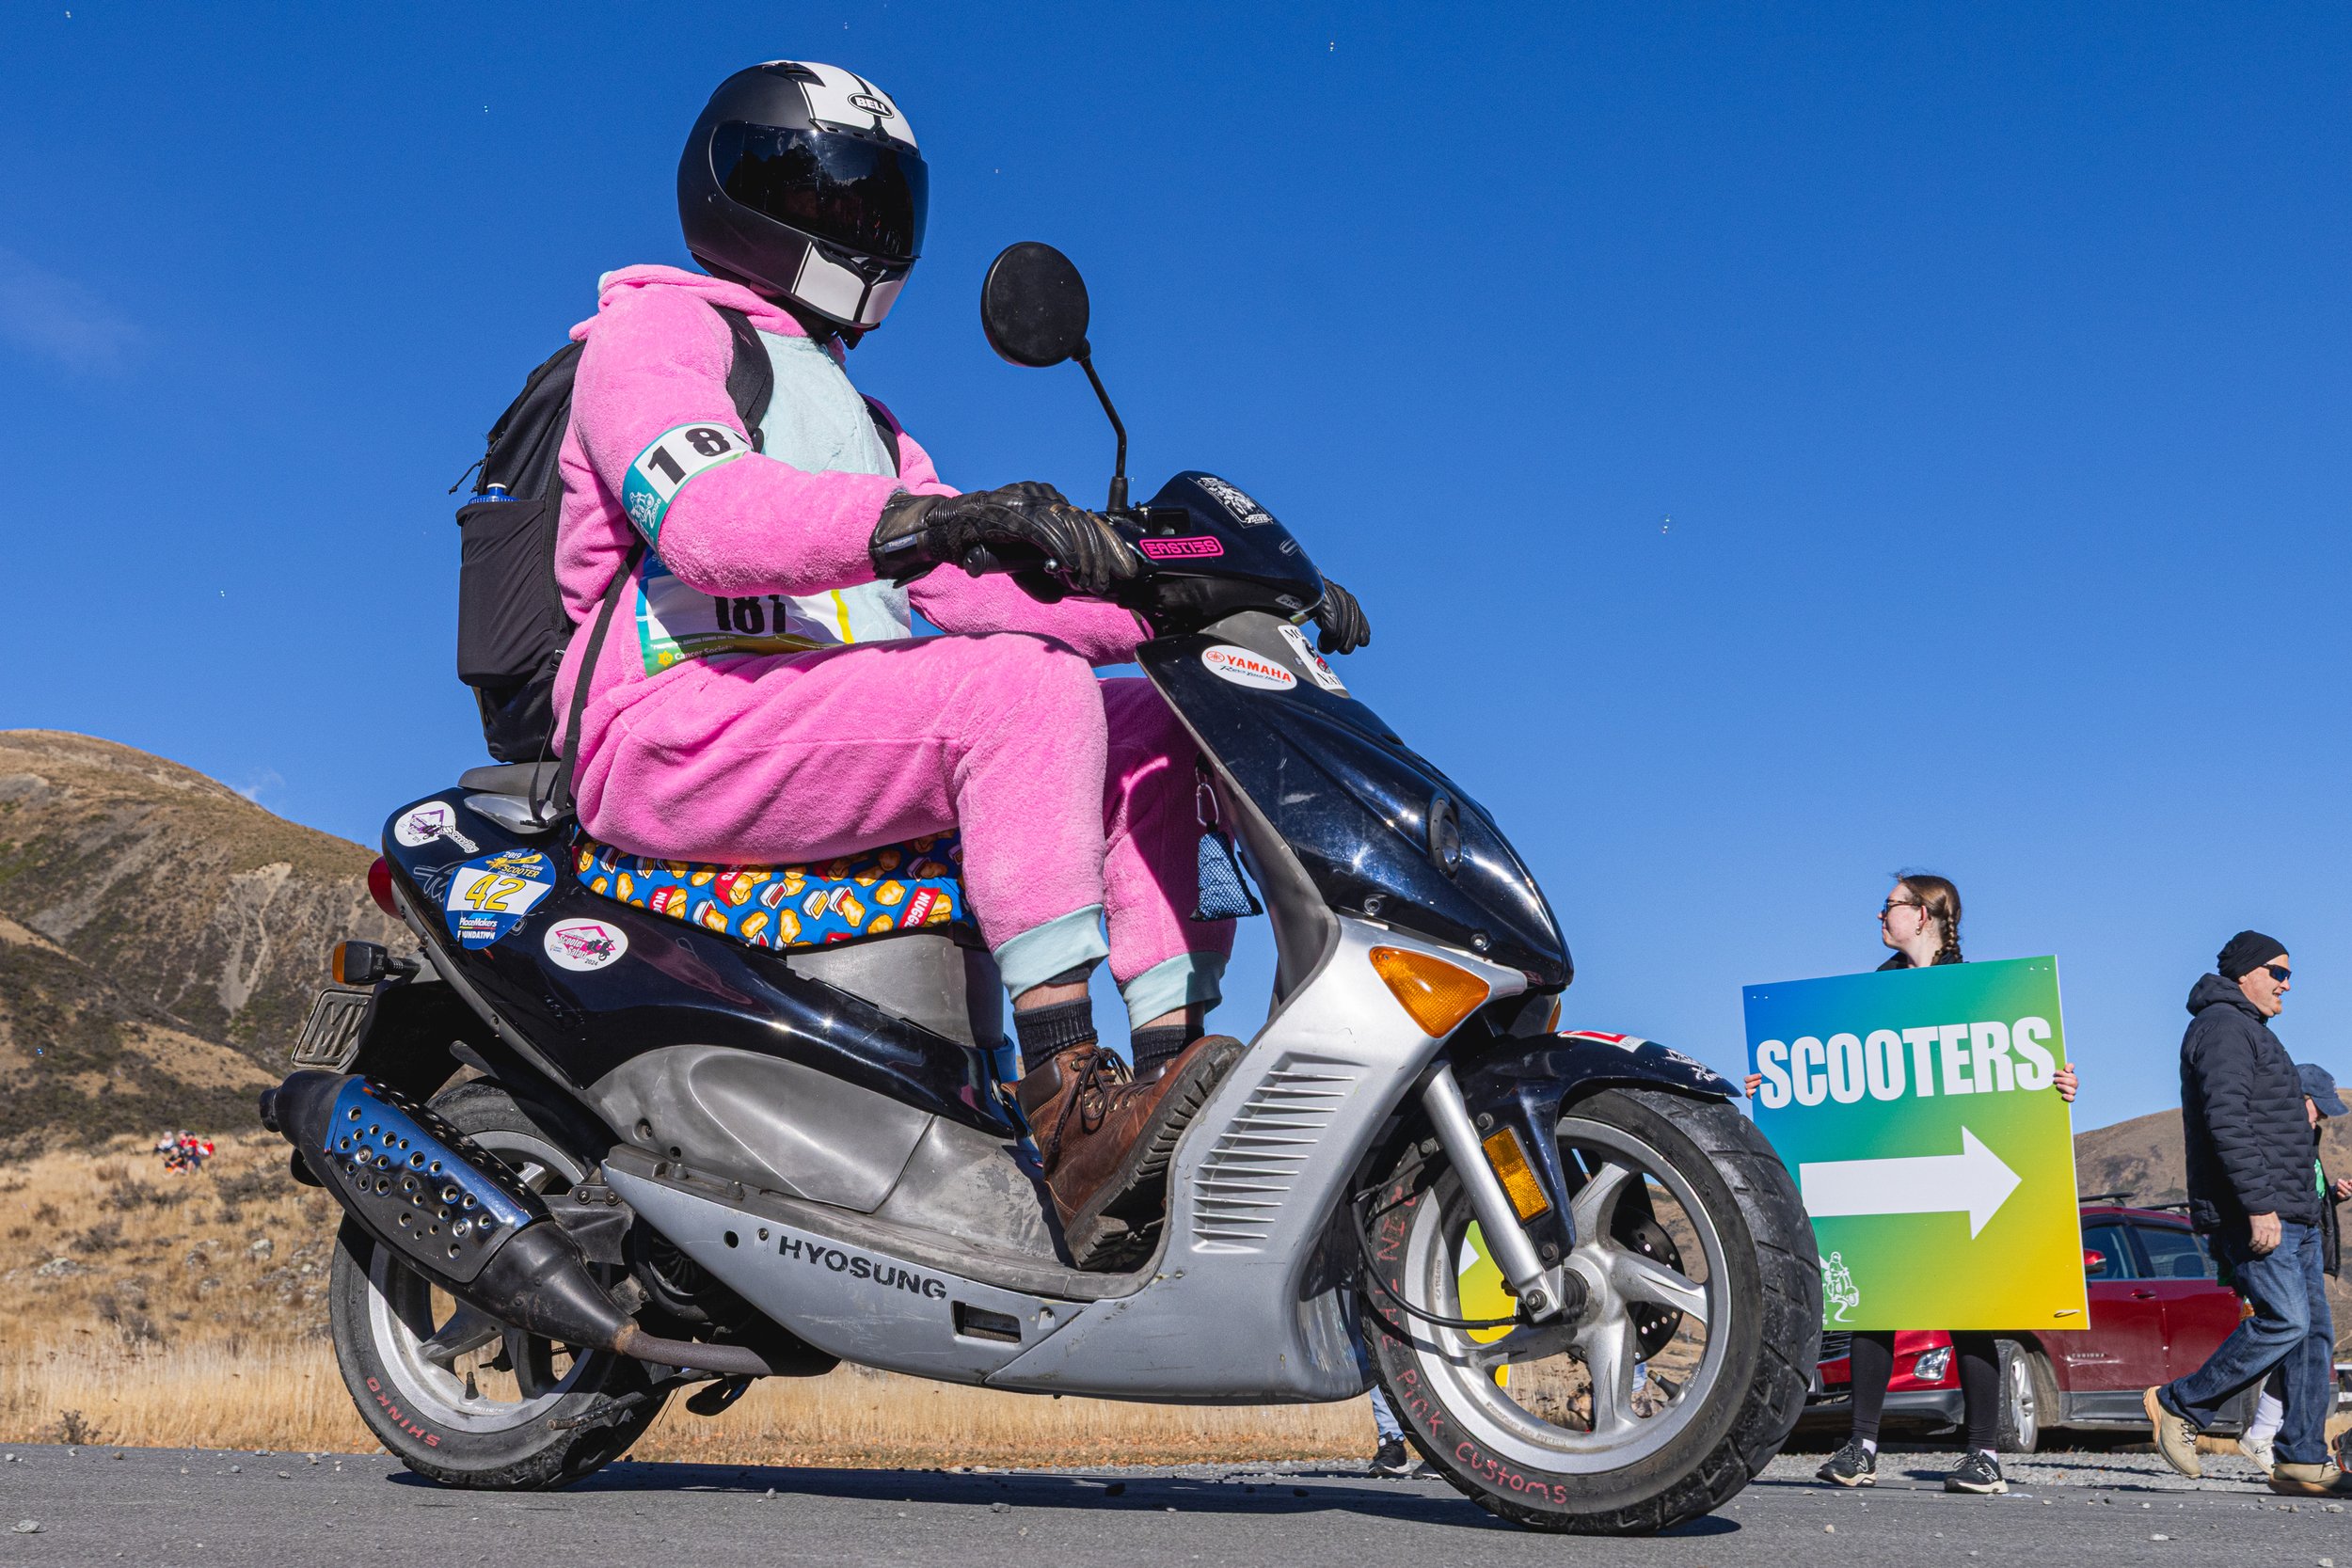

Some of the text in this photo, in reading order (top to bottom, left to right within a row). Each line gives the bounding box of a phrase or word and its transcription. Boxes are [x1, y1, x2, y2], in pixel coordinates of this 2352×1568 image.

[854, 96, 889, 115] BELL
[1144, 540, 1218, 555] EASTIES
[674, 649, 703, 660] Cancer
[1226, 655, 1292, 683] YAMAHA
[502, 850, 522, 860] 2019
[501, 865, 540, 879] SCOOTER
[465, 873, 527, 911] 42
[459, 916, 499, 927] PlaceMakers
[559, 934, 585, 948] Scooter
[1756, 1016, 2057, 1110] SCOOTERS
[778, 1235, 947, 1301] HYOSUNG
[366, 1376, 441, 1448] SHINKO
